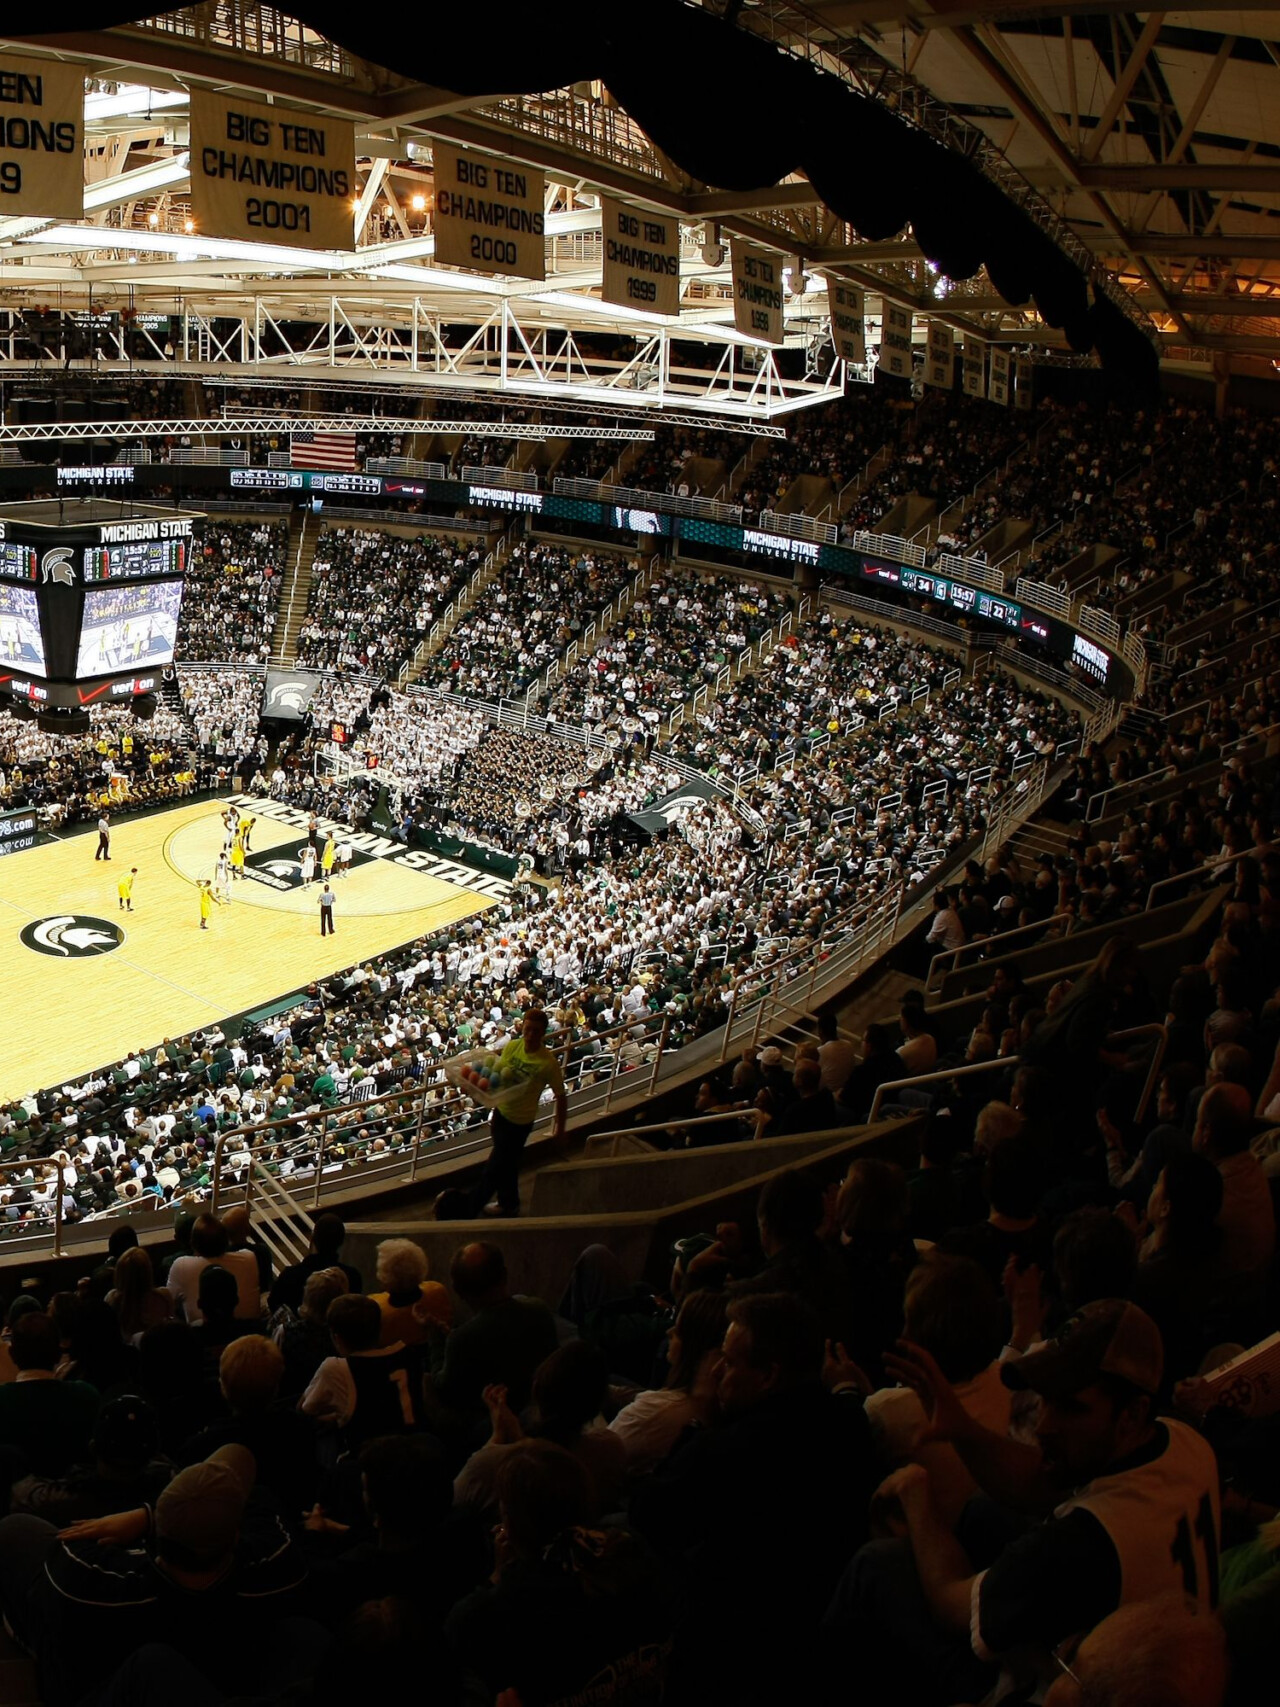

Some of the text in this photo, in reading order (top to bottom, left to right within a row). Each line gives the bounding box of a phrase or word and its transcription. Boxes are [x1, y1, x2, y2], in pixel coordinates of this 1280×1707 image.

[226, 112, 326, 156] BIG TEN
[202, 147, 350, 198] CHAMPIONS
[456, 158, 526, 198] BIG TEN
[246, 198, 311, 232] 2001
[437, 190, 544, 236] CHAMPIONS
[618, 212, 666, 244] BIG TEN
[470, 234, 516, 266] 2000
[607, 239, 677, 276] CHAMPIONS
[626, 278, 656, 302] 1999
[738, 278, 780, 310] CHAMPIONS
[56, 466, 134, 479] MICHIGAN STATE
[469, 486, 543, 507] MICHIGAN STATE
[469, 498, 542, 514] UNIVERSITY
[100, 520, 194, 544] MICHIGAN STATE
[124, 545, 148, 556] 15:57
[743, 530, 820, 558] MICHIGAN STATE
[743, 543, 818, 566] UNIVERSITY
[110, 567, 122, 576] 34
[150, 563, 160, 572] 22
[918, 579, 930, 592] 34
[952, 586, 974, 603] 15:57
[993, 605, 1004, 619] 22
[11, 680, 47, 700] verizon
[112, 678, 154, 695] verizon
[372, 820, 388, 832] xfinity
[220, 793, 516, 901] MICHIGAN STATE
